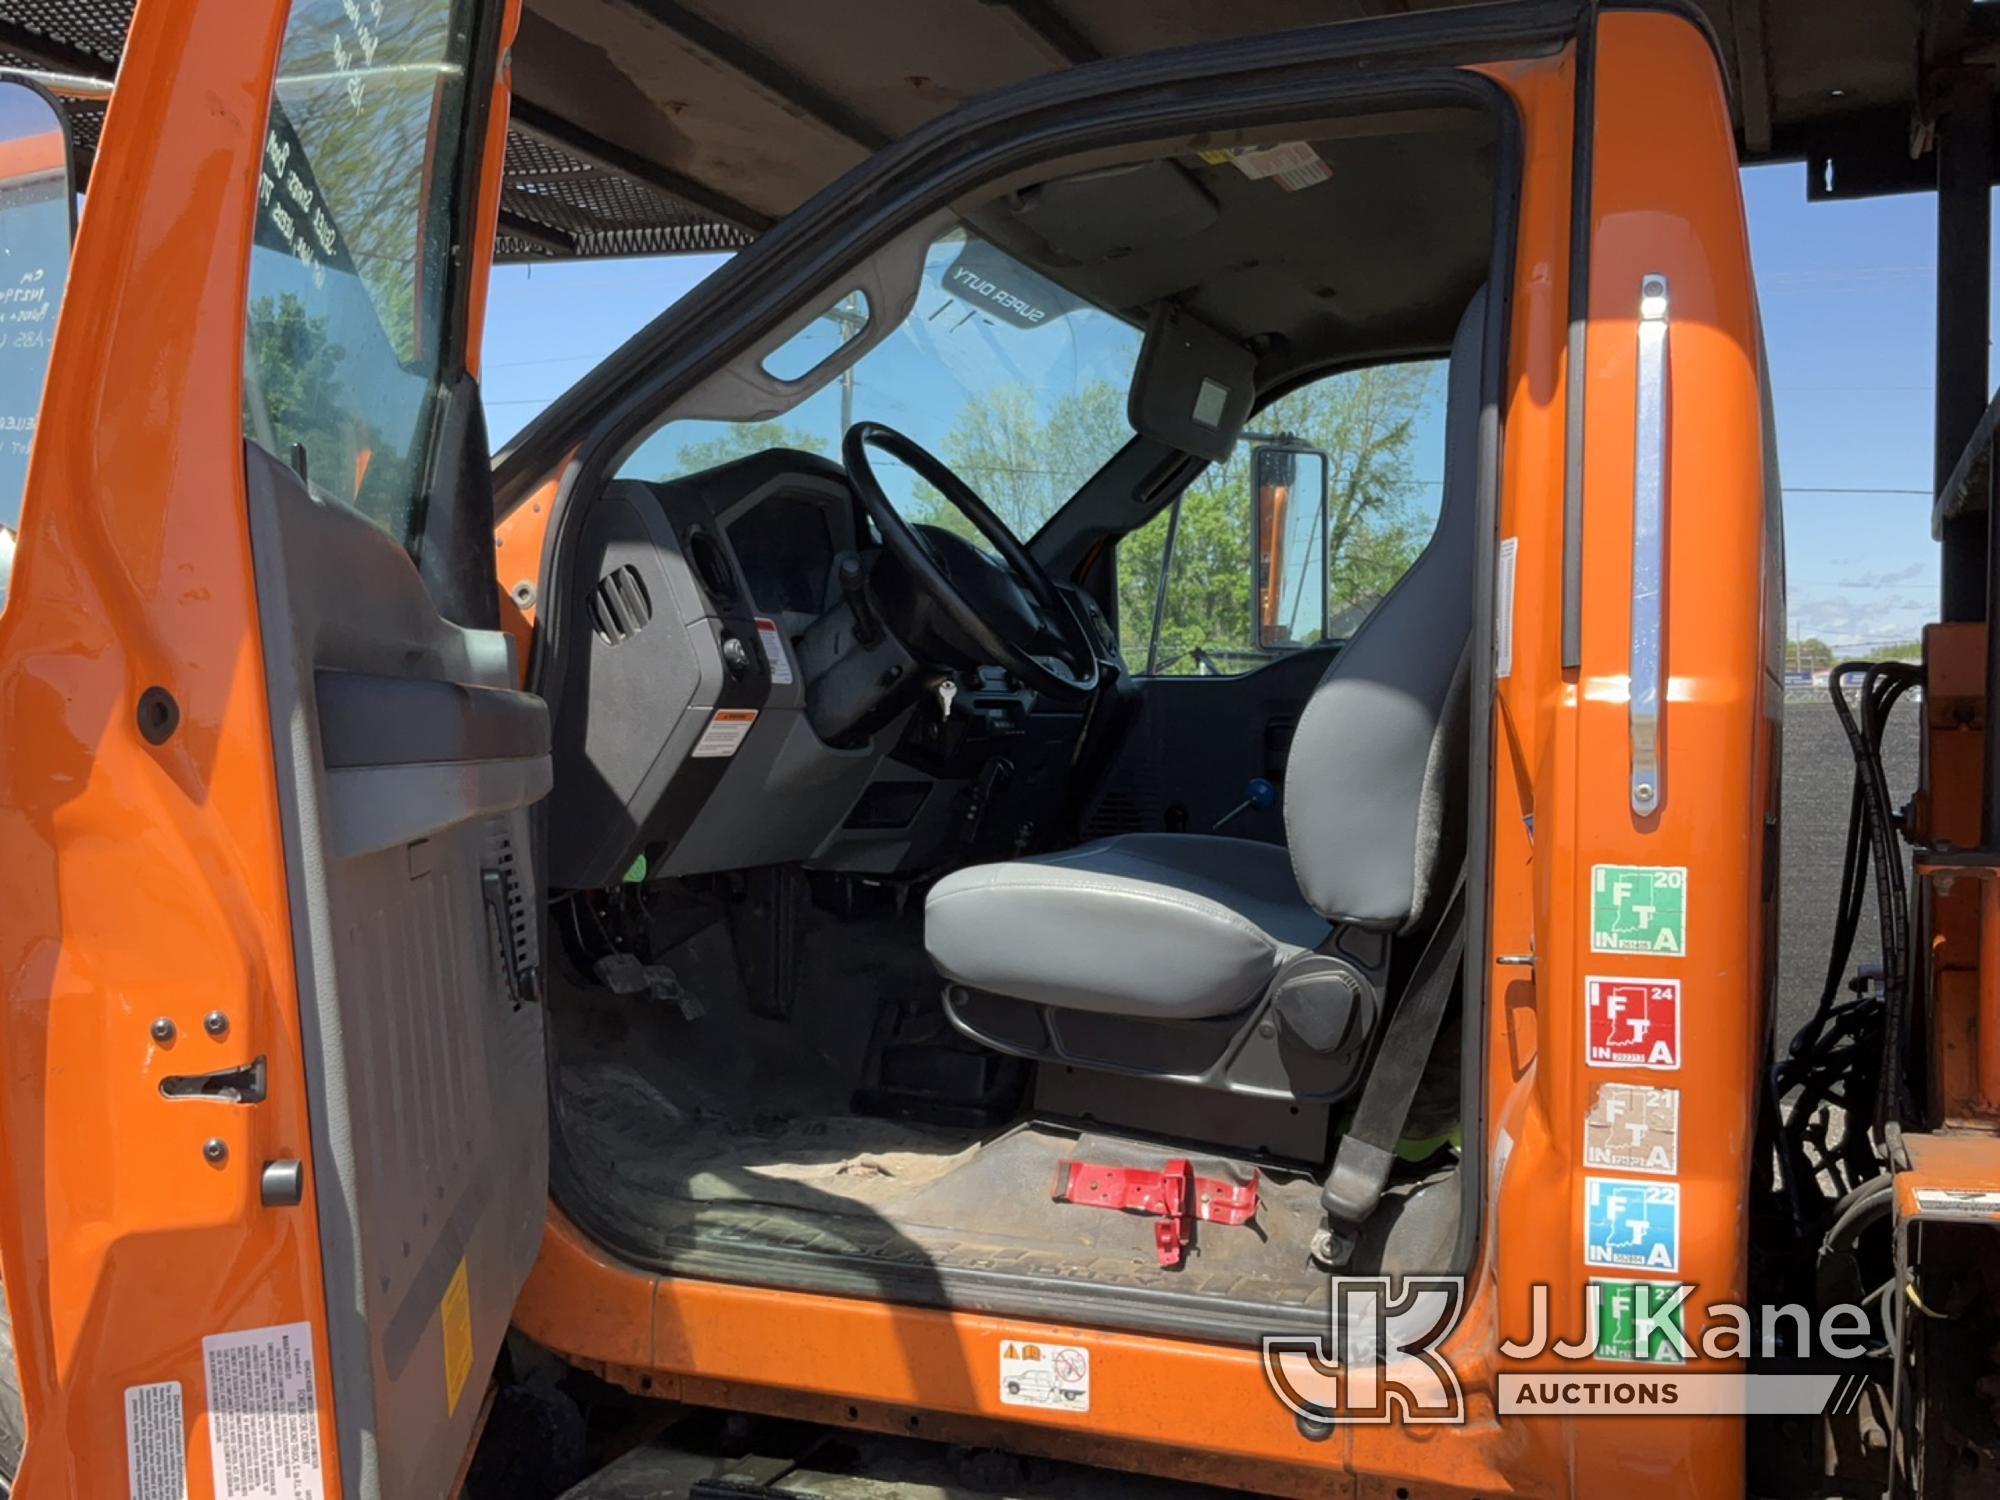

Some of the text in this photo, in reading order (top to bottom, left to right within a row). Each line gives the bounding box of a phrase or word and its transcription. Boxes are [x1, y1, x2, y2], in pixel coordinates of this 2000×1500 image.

[1654, 872, 1681, 888] 20
[1613, 882, 1633, 906] F
[1653, 927, 1679, 951] A
[1595, 931, 1618, 949] IN
[1651, 987, 1673, 1000] 24
[1607, 996, 1627, 1020] F
[1648, 1040, 1674, 1064] A
[1592, 1046, 1611, 1060] IN
[1647, 1091, 1672, 1108] 21
[1606, 1100, 1626, 1123] F
[1646, 1145, 1670, 1168] A
[1588, 1146, 1612, 1164] IN
[1646, 1187, 1674, 1201] 22
[1607, 1196, 1627, 1220] F
[1647, 1243, 1672, 1267] A
[1590, 1245, 1613, 1262] IN
